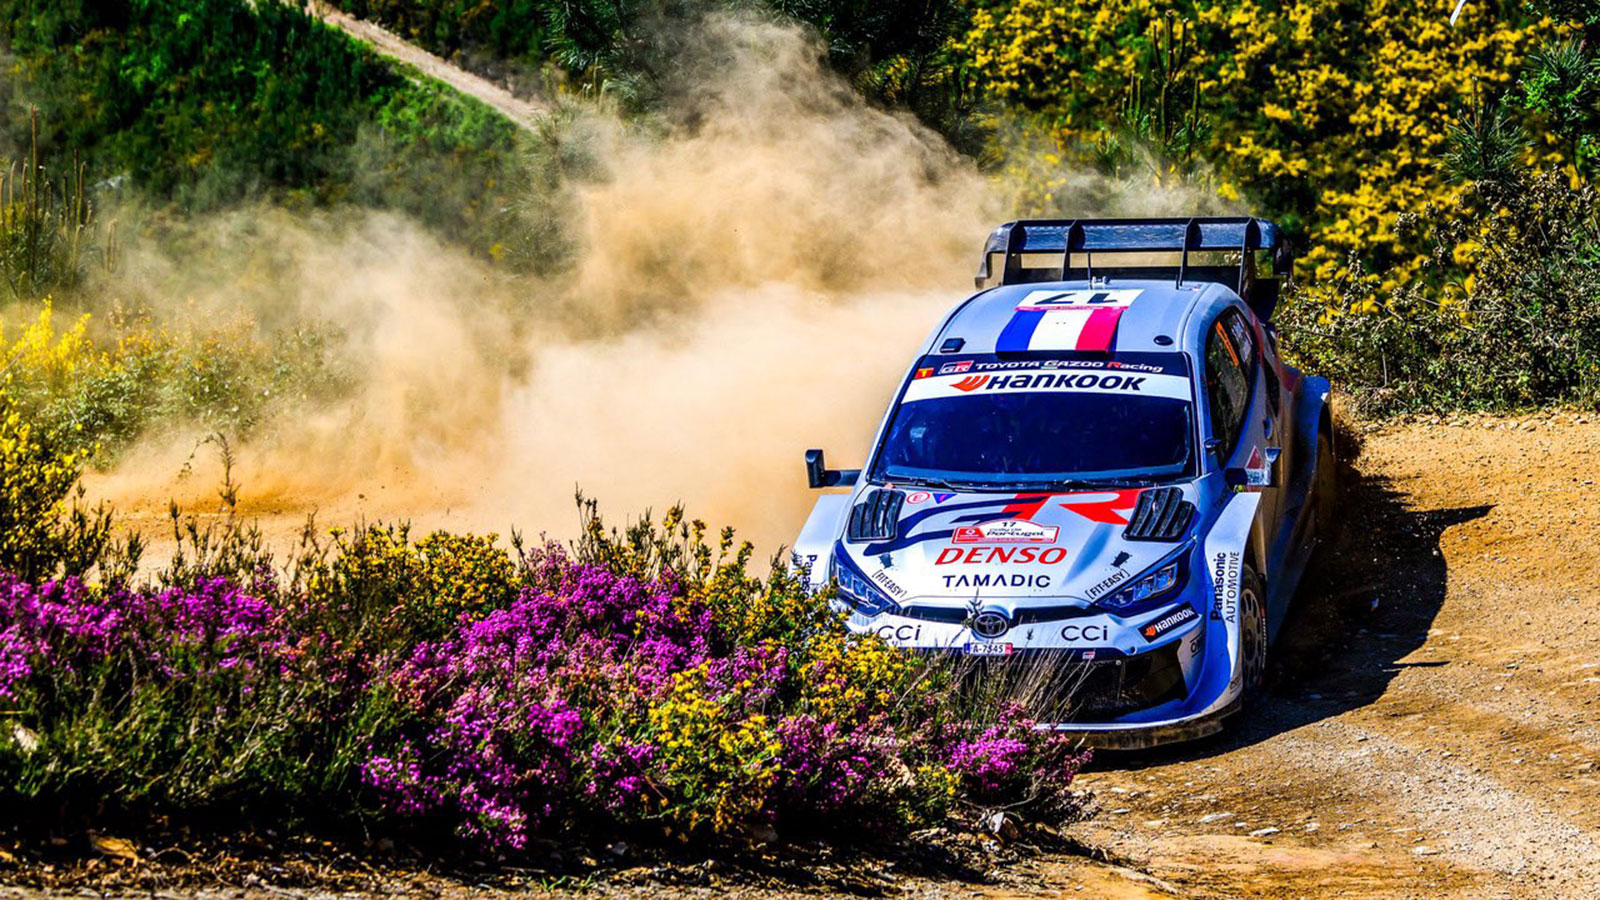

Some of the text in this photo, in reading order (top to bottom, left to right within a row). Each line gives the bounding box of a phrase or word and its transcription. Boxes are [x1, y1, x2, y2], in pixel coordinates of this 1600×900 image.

[975, 360, 1164, 373] TOYOTA GAZOO Racing
[986, 530, 1045, 538] Portugal
[935, 547, 1067, 566] DENSO
[942, 574, 1051, 588] TAMADIC
[1210, 552, 1227, 621] Panasonic
[1226, 551, 1240, 623] AUTOMOTIVE
